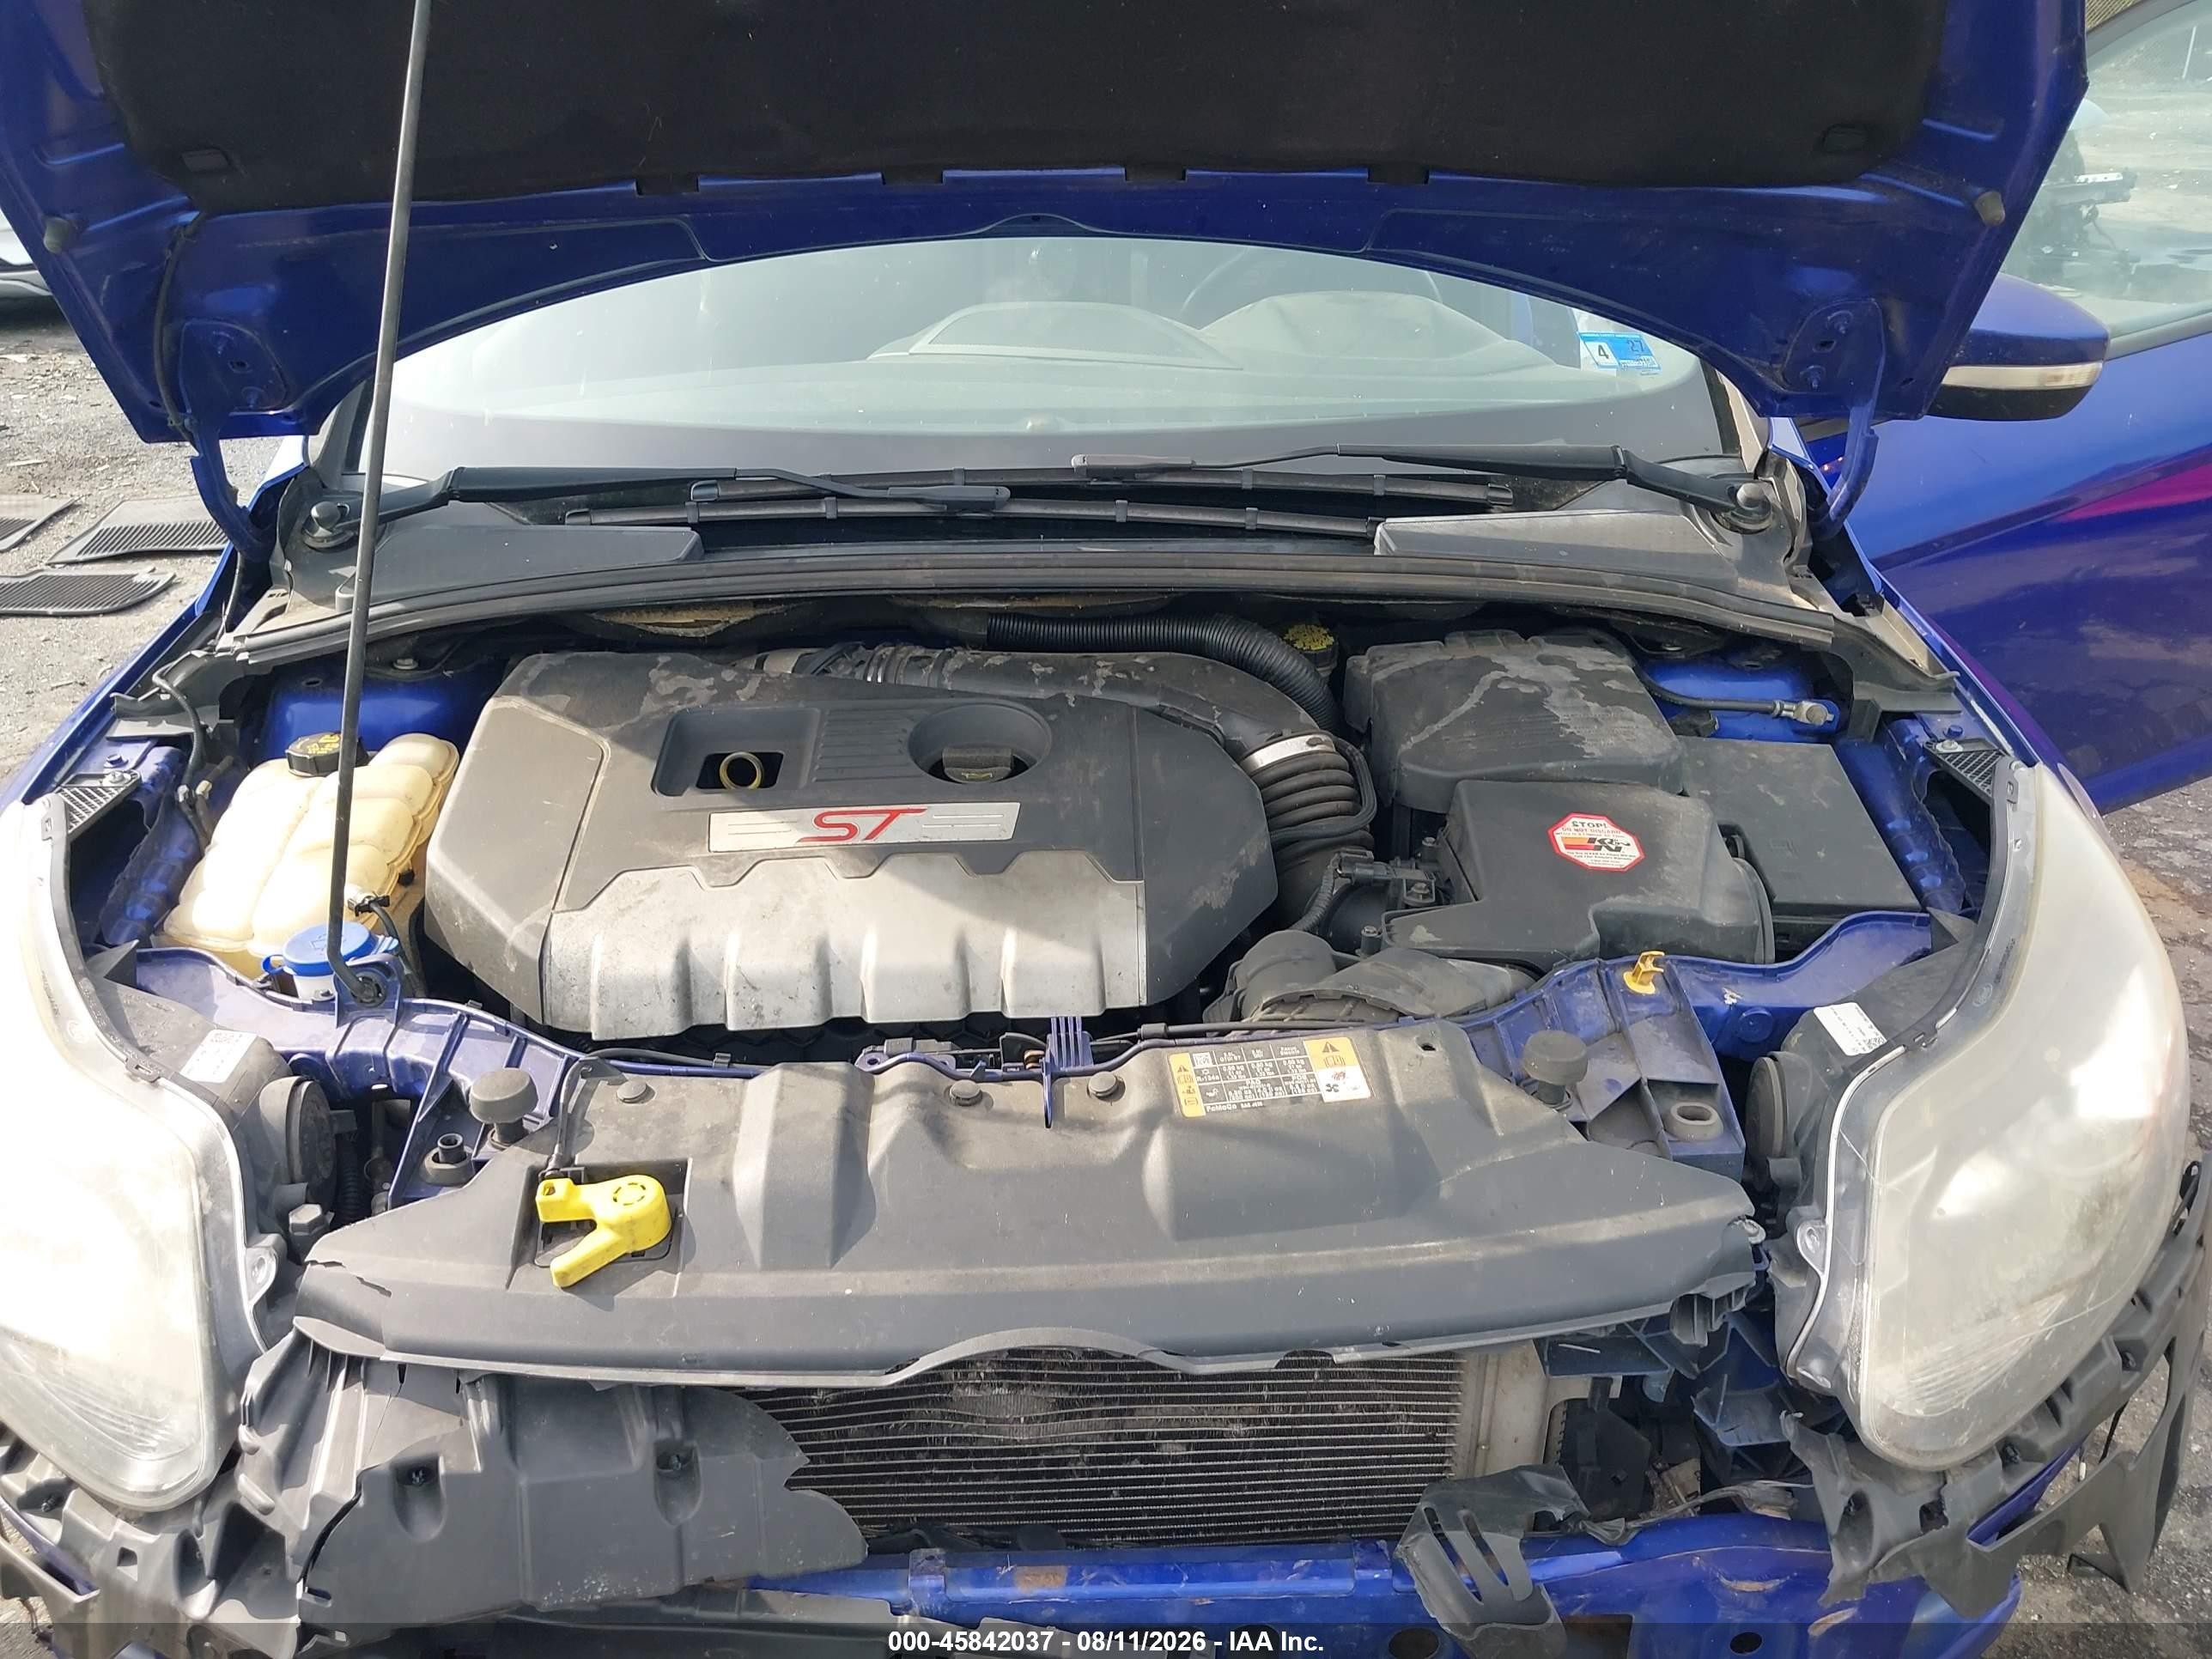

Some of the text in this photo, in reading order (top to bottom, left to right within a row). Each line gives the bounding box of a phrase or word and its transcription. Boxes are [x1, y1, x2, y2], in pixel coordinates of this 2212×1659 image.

[1598, 344, 1609, 360] 4
[797, 808, 928, 842] ST
[1571, 820, 1608, 829] STOP!
[1206, 1103, 1237, 1112] FoMoCo
